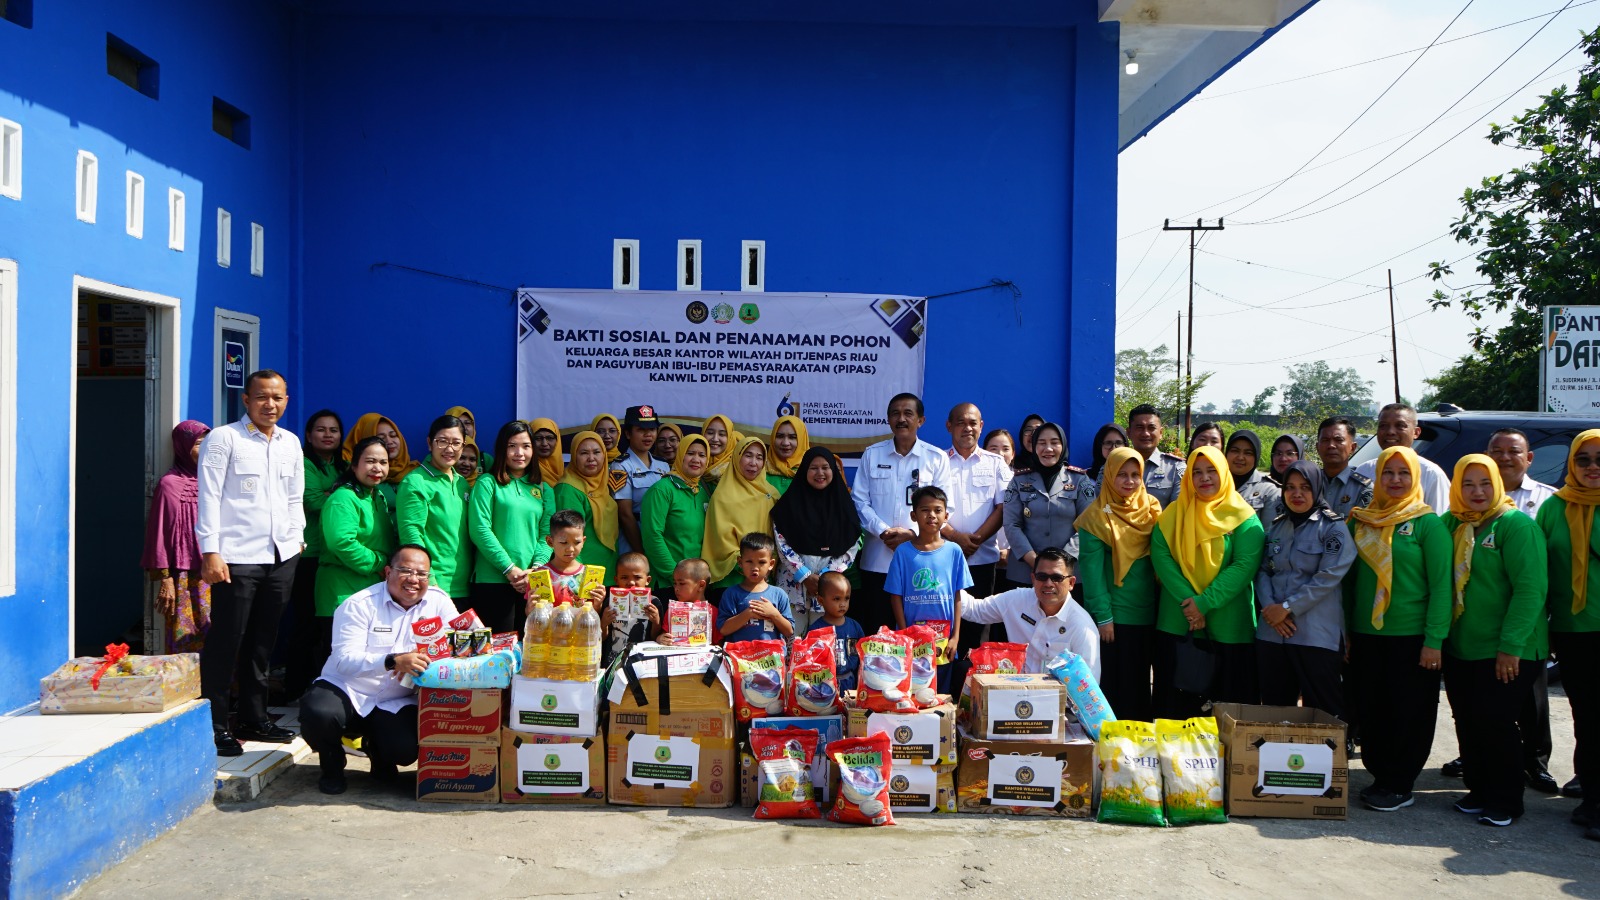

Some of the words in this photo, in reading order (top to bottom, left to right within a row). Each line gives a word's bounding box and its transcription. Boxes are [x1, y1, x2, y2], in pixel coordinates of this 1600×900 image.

[553, 329, 604, 342] BAKTI
[608, 330, 670, 343] SOSIAL
[675, 331, 711, 344] DAN
[715, 332, 825, 346] PENANAMAN
[830, 334, 891, 348] POHON
[565, 347, 630, 357] KELUARGA
[632, 348, 671, 357] BESAR
[675, 349, 724, 359] KANTOR
[727, 350, 781, 360] WILAYAH
[784, 351, 847, 361] DITJENPAS
[850, 353, 878, 362] RIAU
[227, 361, 241, 371] Dulux
[567, 359, 592, 368] DAN
[595, 360, 669, 370] PAGUYUBAN
[672, 361, 716, 371] IBU-IBU
[719, 362, 830, 373] PEMASYARAKATAN
[833, 364, 877, 375] (PIPAS)
[649, 373, 697, 382] KANWIL
[700, 374, 763, 384] DITJENPAS
[766, 375, 795, 384] RIAU
[803, 417, 863, 425] KEMENTERIAN
[420, 622, 436, 633] SGM
[456, 617, 468, 629] SGM
[449, 724, 485, 732] goreng
[843, 755, 875, 765] Belida
[1124, 755, 1159, 768] SPHP
[1184, 757, 1217, 769] SPHP
[452, 782, 475, 791] Ayam
